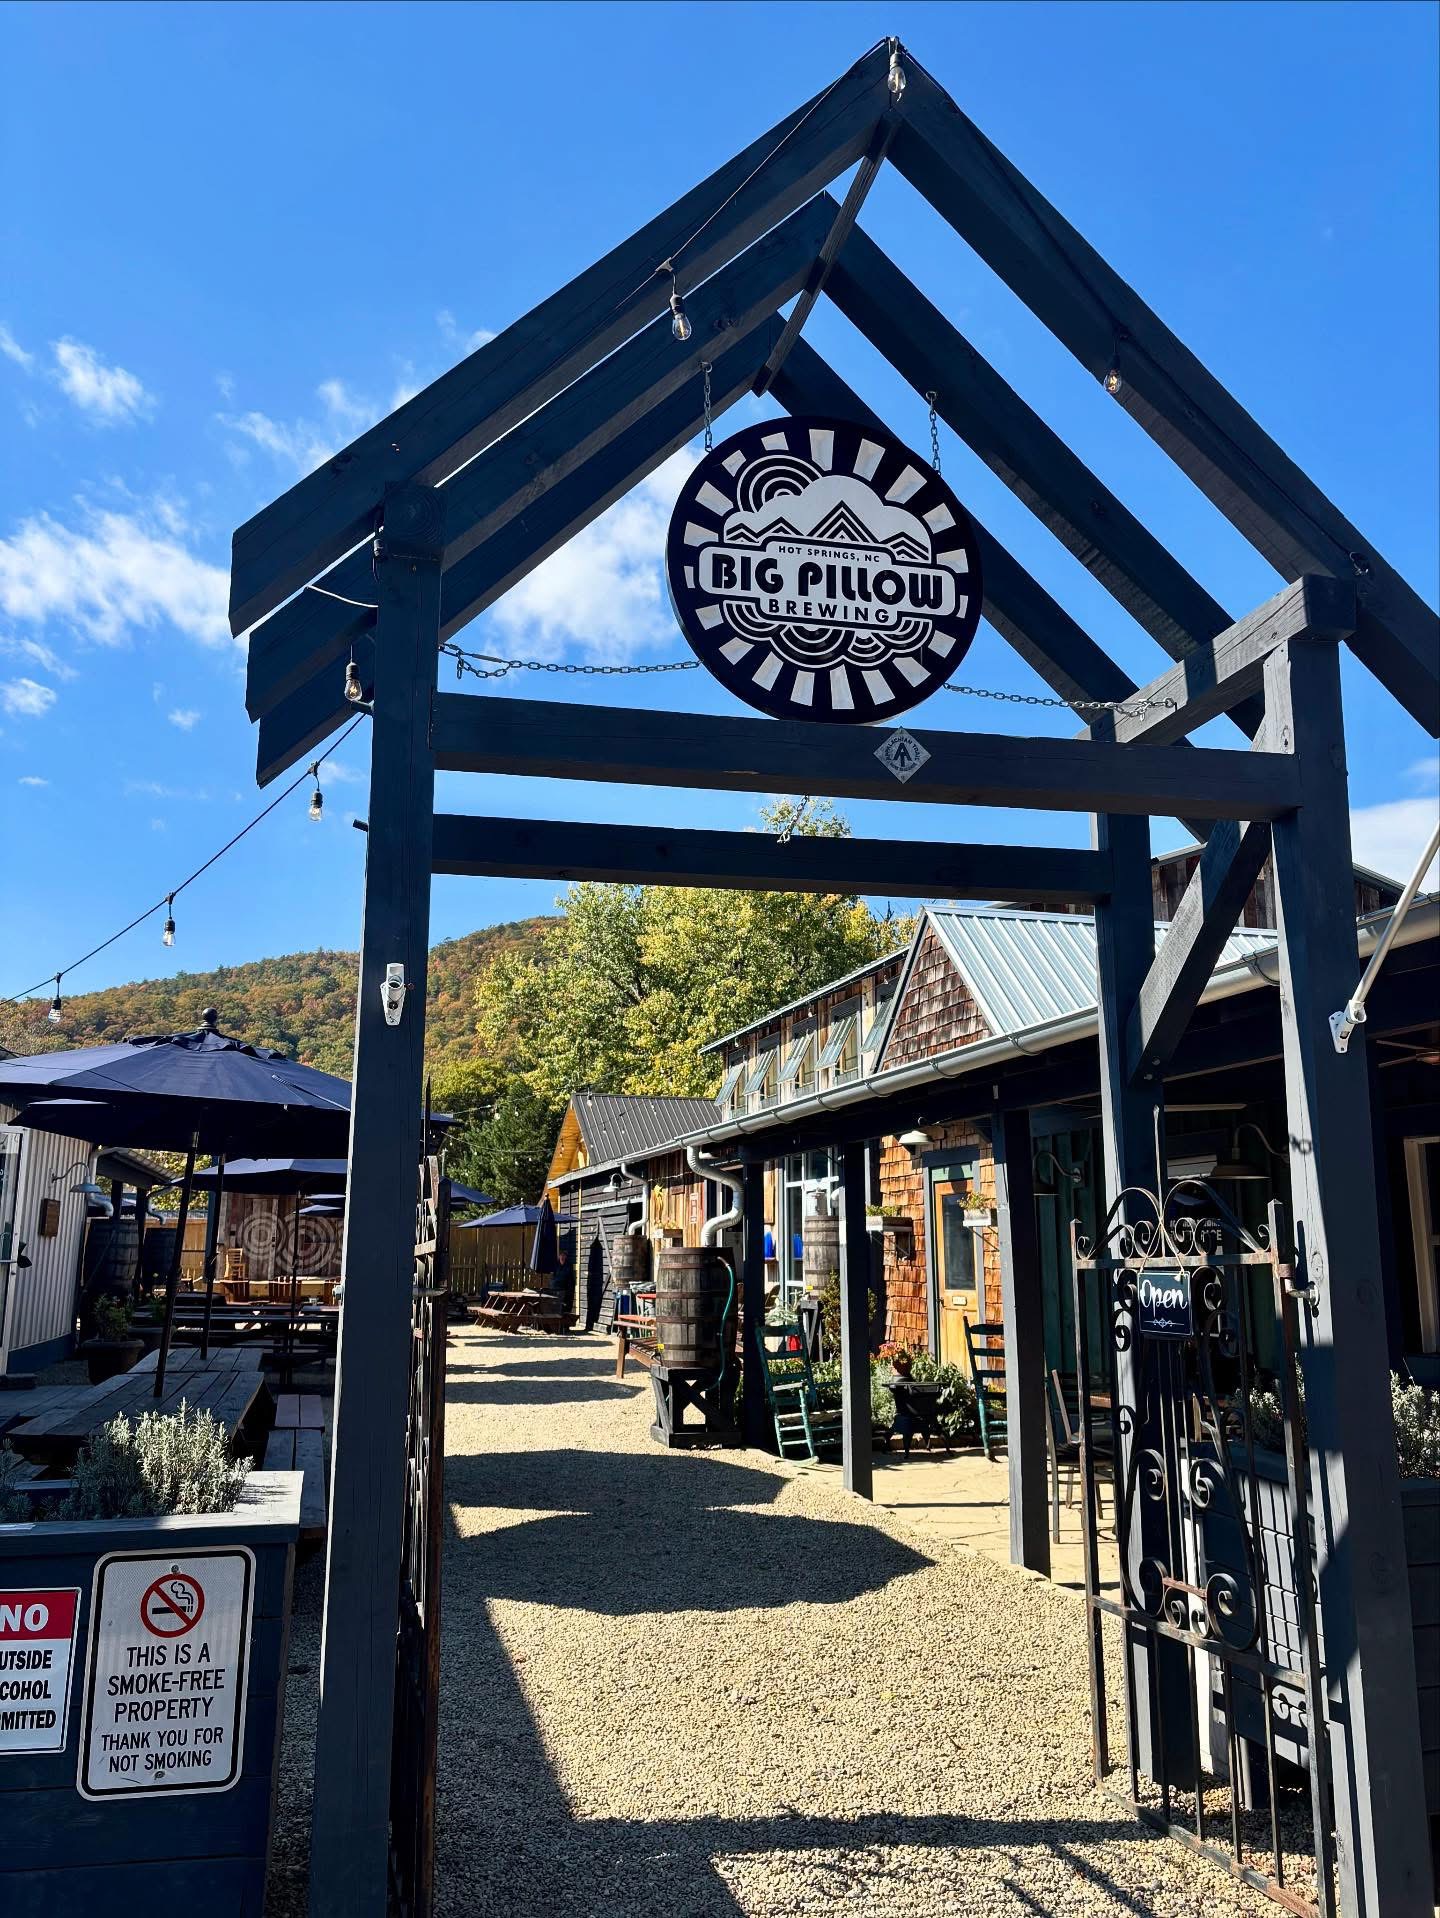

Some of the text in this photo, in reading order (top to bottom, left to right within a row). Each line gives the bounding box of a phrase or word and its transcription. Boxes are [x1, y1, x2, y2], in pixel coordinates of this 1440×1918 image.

[778, 545, 880, 563] HOT SPRINGS, NC
[711, 553, 943, 610] BIG PILLOW
[768, 599, 890, 624] BREWING
[1140, 1279, 1188, 1318] Open
[0, 1603, 49, 1632] NO
[126, 1642, 211, 1668] THIS IS A
[106, 1668, 226, 1696] SMOKE-FREE
[0, 1709, 57, 1730] MITTED
[114, 1697, 214, 1723] PROPERTY
[101, 1726, 224, 1751] THANK YOU FOR
[109, 1749, 212, 1773] NOT SMOKING
